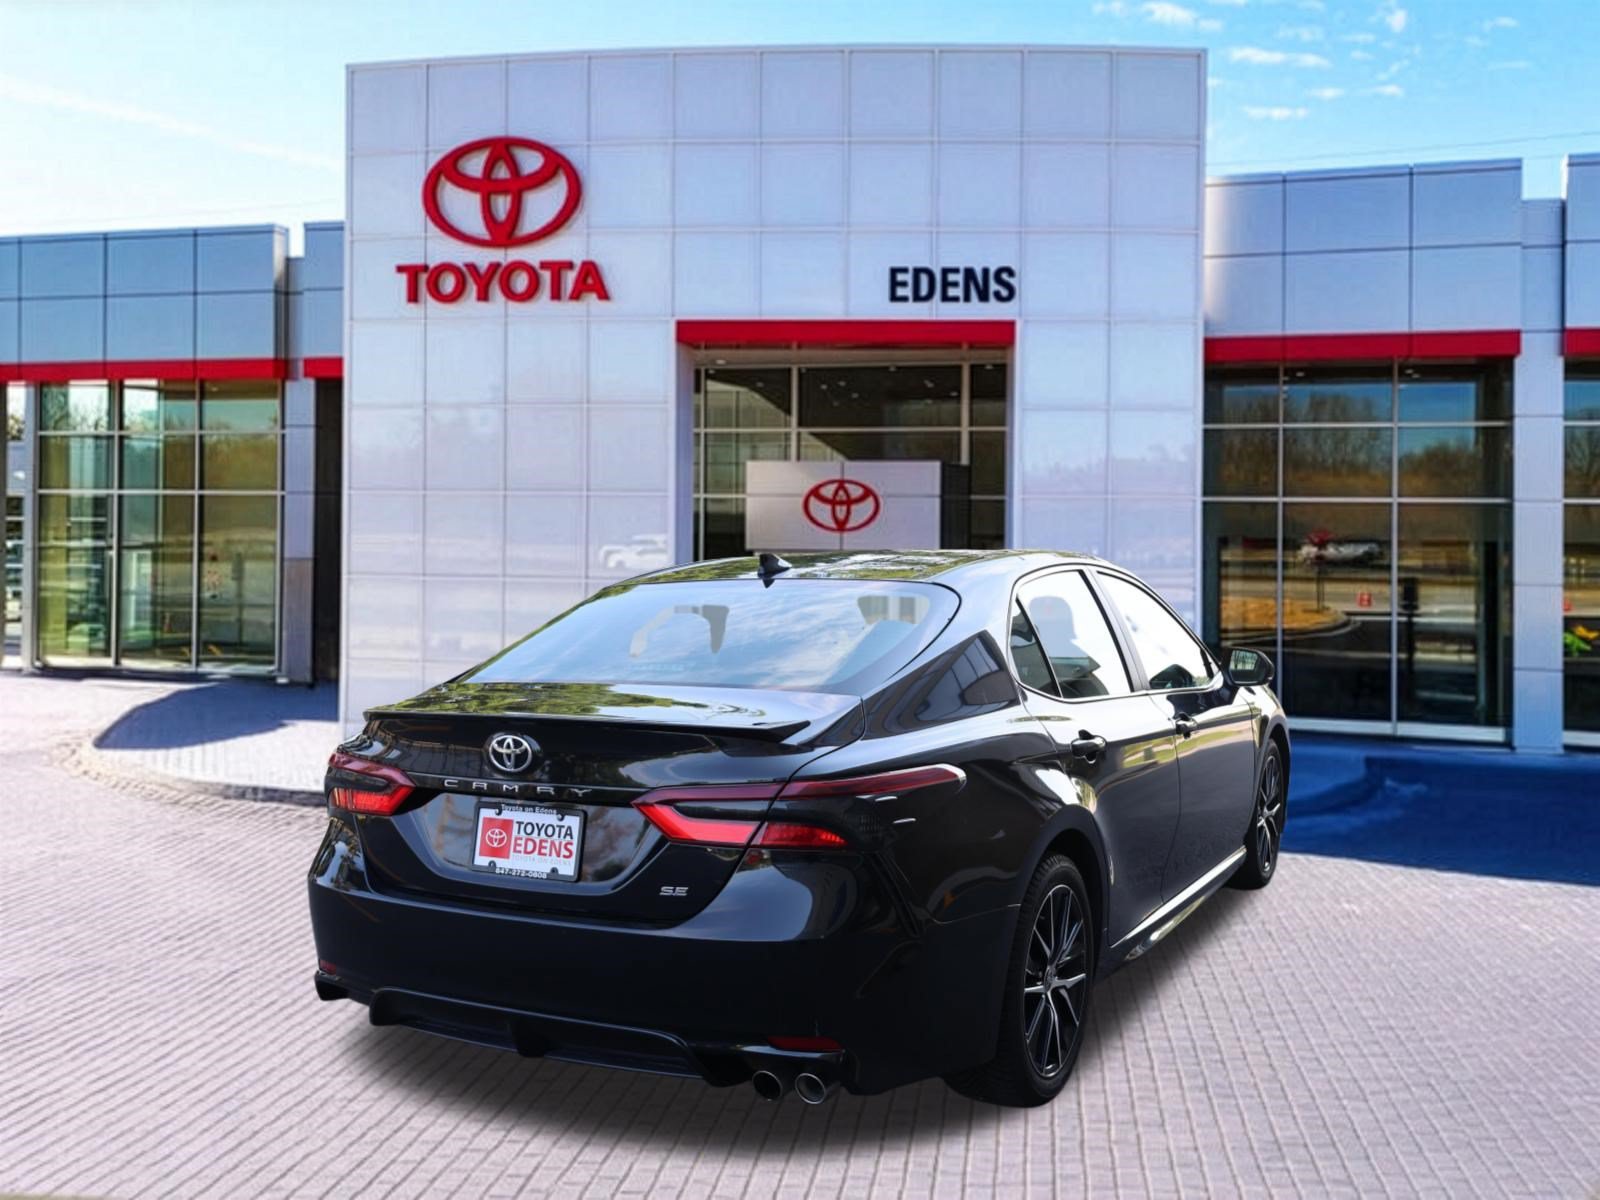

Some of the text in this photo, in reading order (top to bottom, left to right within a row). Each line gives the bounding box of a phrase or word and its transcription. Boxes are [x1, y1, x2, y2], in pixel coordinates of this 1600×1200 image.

[397, 260, 610, 303] TOYOTA
[889, 266, 1017, 302] EDENS
[443, 779, 593, 797] CAMRY
[501, 804, 523, 813] Toyota
[516, 821, 573, 840] TOYOTA
[513, 836, 574, 859] EDENS
[659, 886, 689, 897] SE
